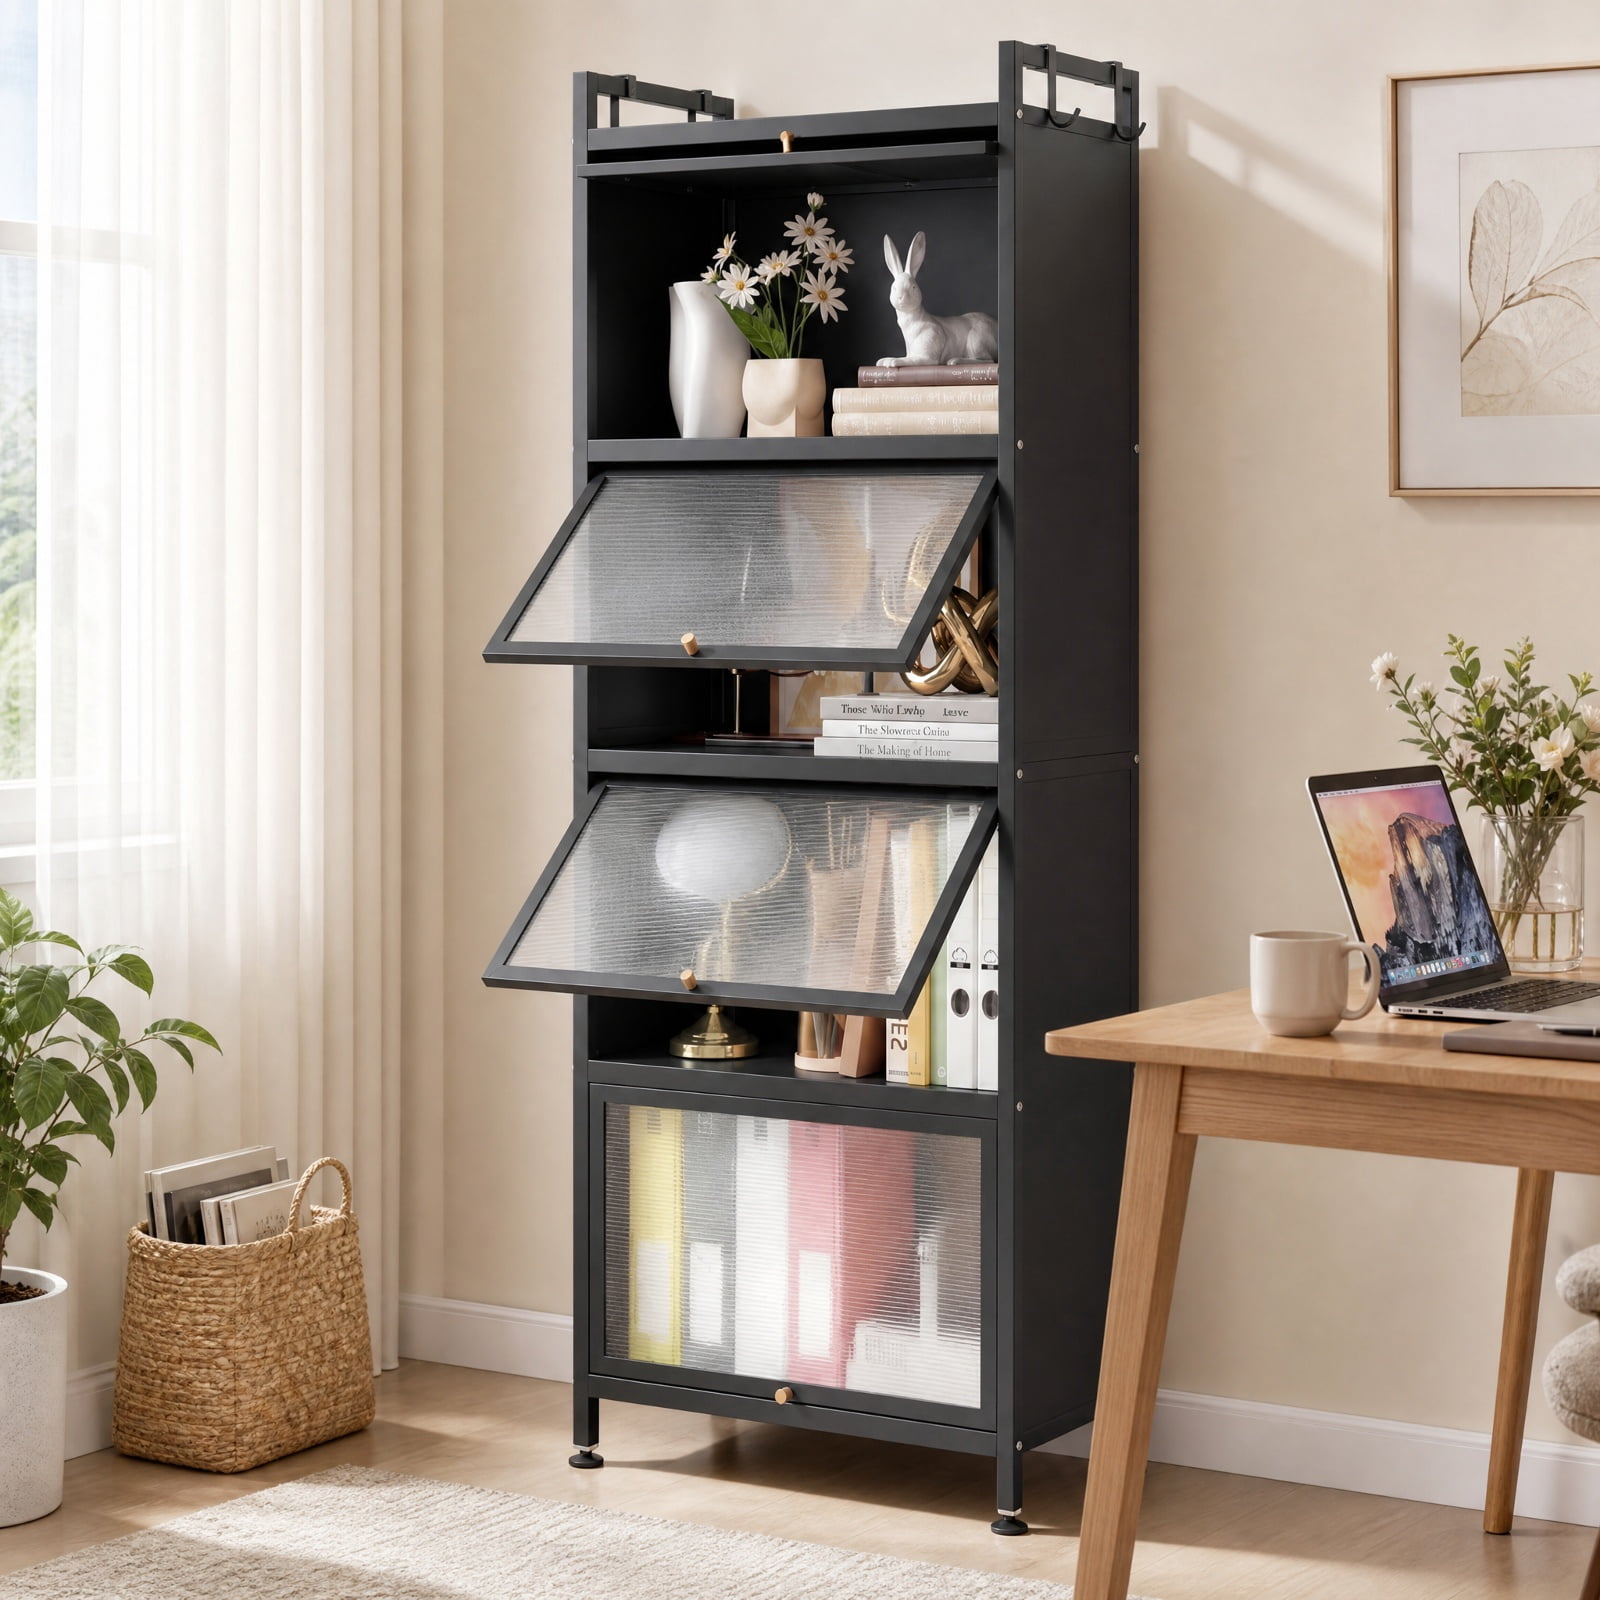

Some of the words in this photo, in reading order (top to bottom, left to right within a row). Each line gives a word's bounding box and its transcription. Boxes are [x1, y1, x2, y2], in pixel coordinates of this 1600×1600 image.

[857, 744, 875, 755] The
[877, 745, 910, 758] Making
[913, 745, 923, 756] of
[925, 745, 951, 757] Home
